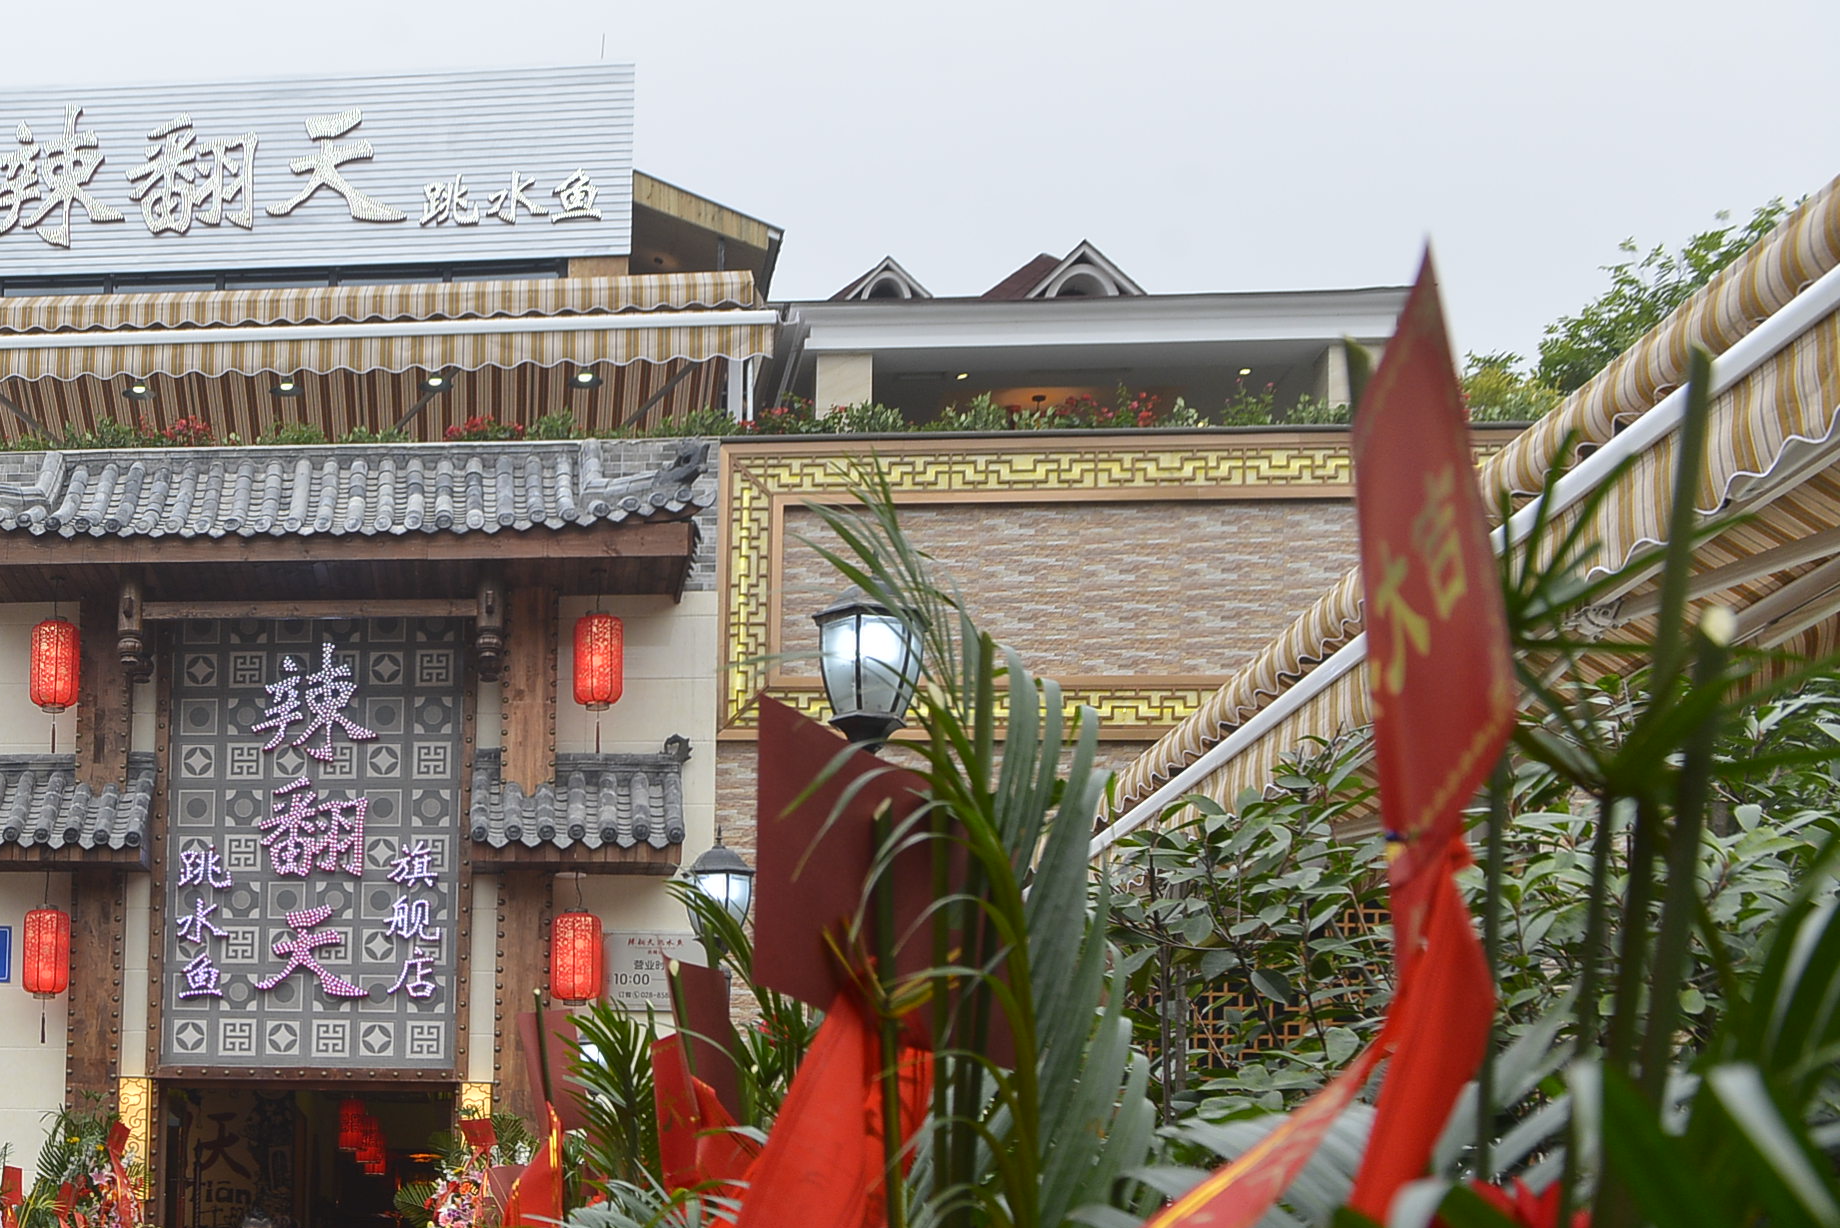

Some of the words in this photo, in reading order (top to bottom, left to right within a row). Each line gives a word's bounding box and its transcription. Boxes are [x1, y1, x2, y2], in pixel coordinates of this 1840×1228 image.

[418, 166, 604, 229] 跳水鱼
[250, 641, 380, 998] 辣翻天
[175, 844, 234, 1000] 跳水鱼
[382, 842, 442, 1000] 旗舰店
[613, 973, 650, 985] 10:00
